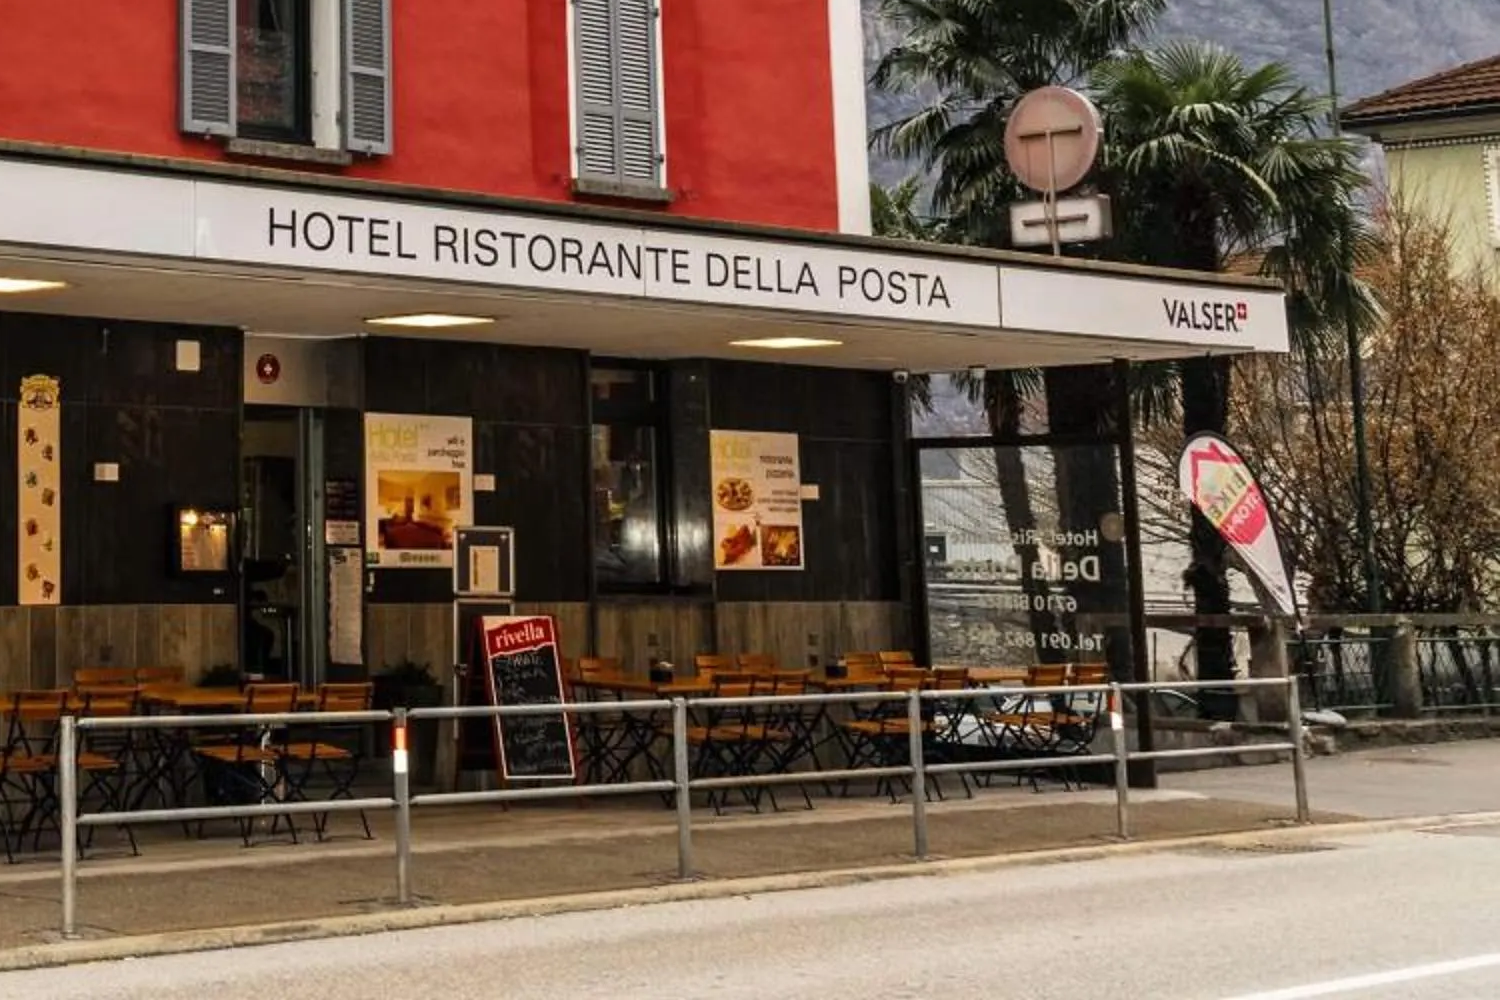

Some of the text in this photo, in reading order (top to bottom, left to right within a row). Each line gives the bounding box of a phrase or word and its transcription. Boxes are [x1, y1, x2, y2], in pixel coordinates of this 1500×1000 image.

[268, 207, 951, 308] HOTEL RISTORANTE DELLA POSTA
[1162, 298, 1238, 332] VALSER
[495, 622, 546, 649] rivella
